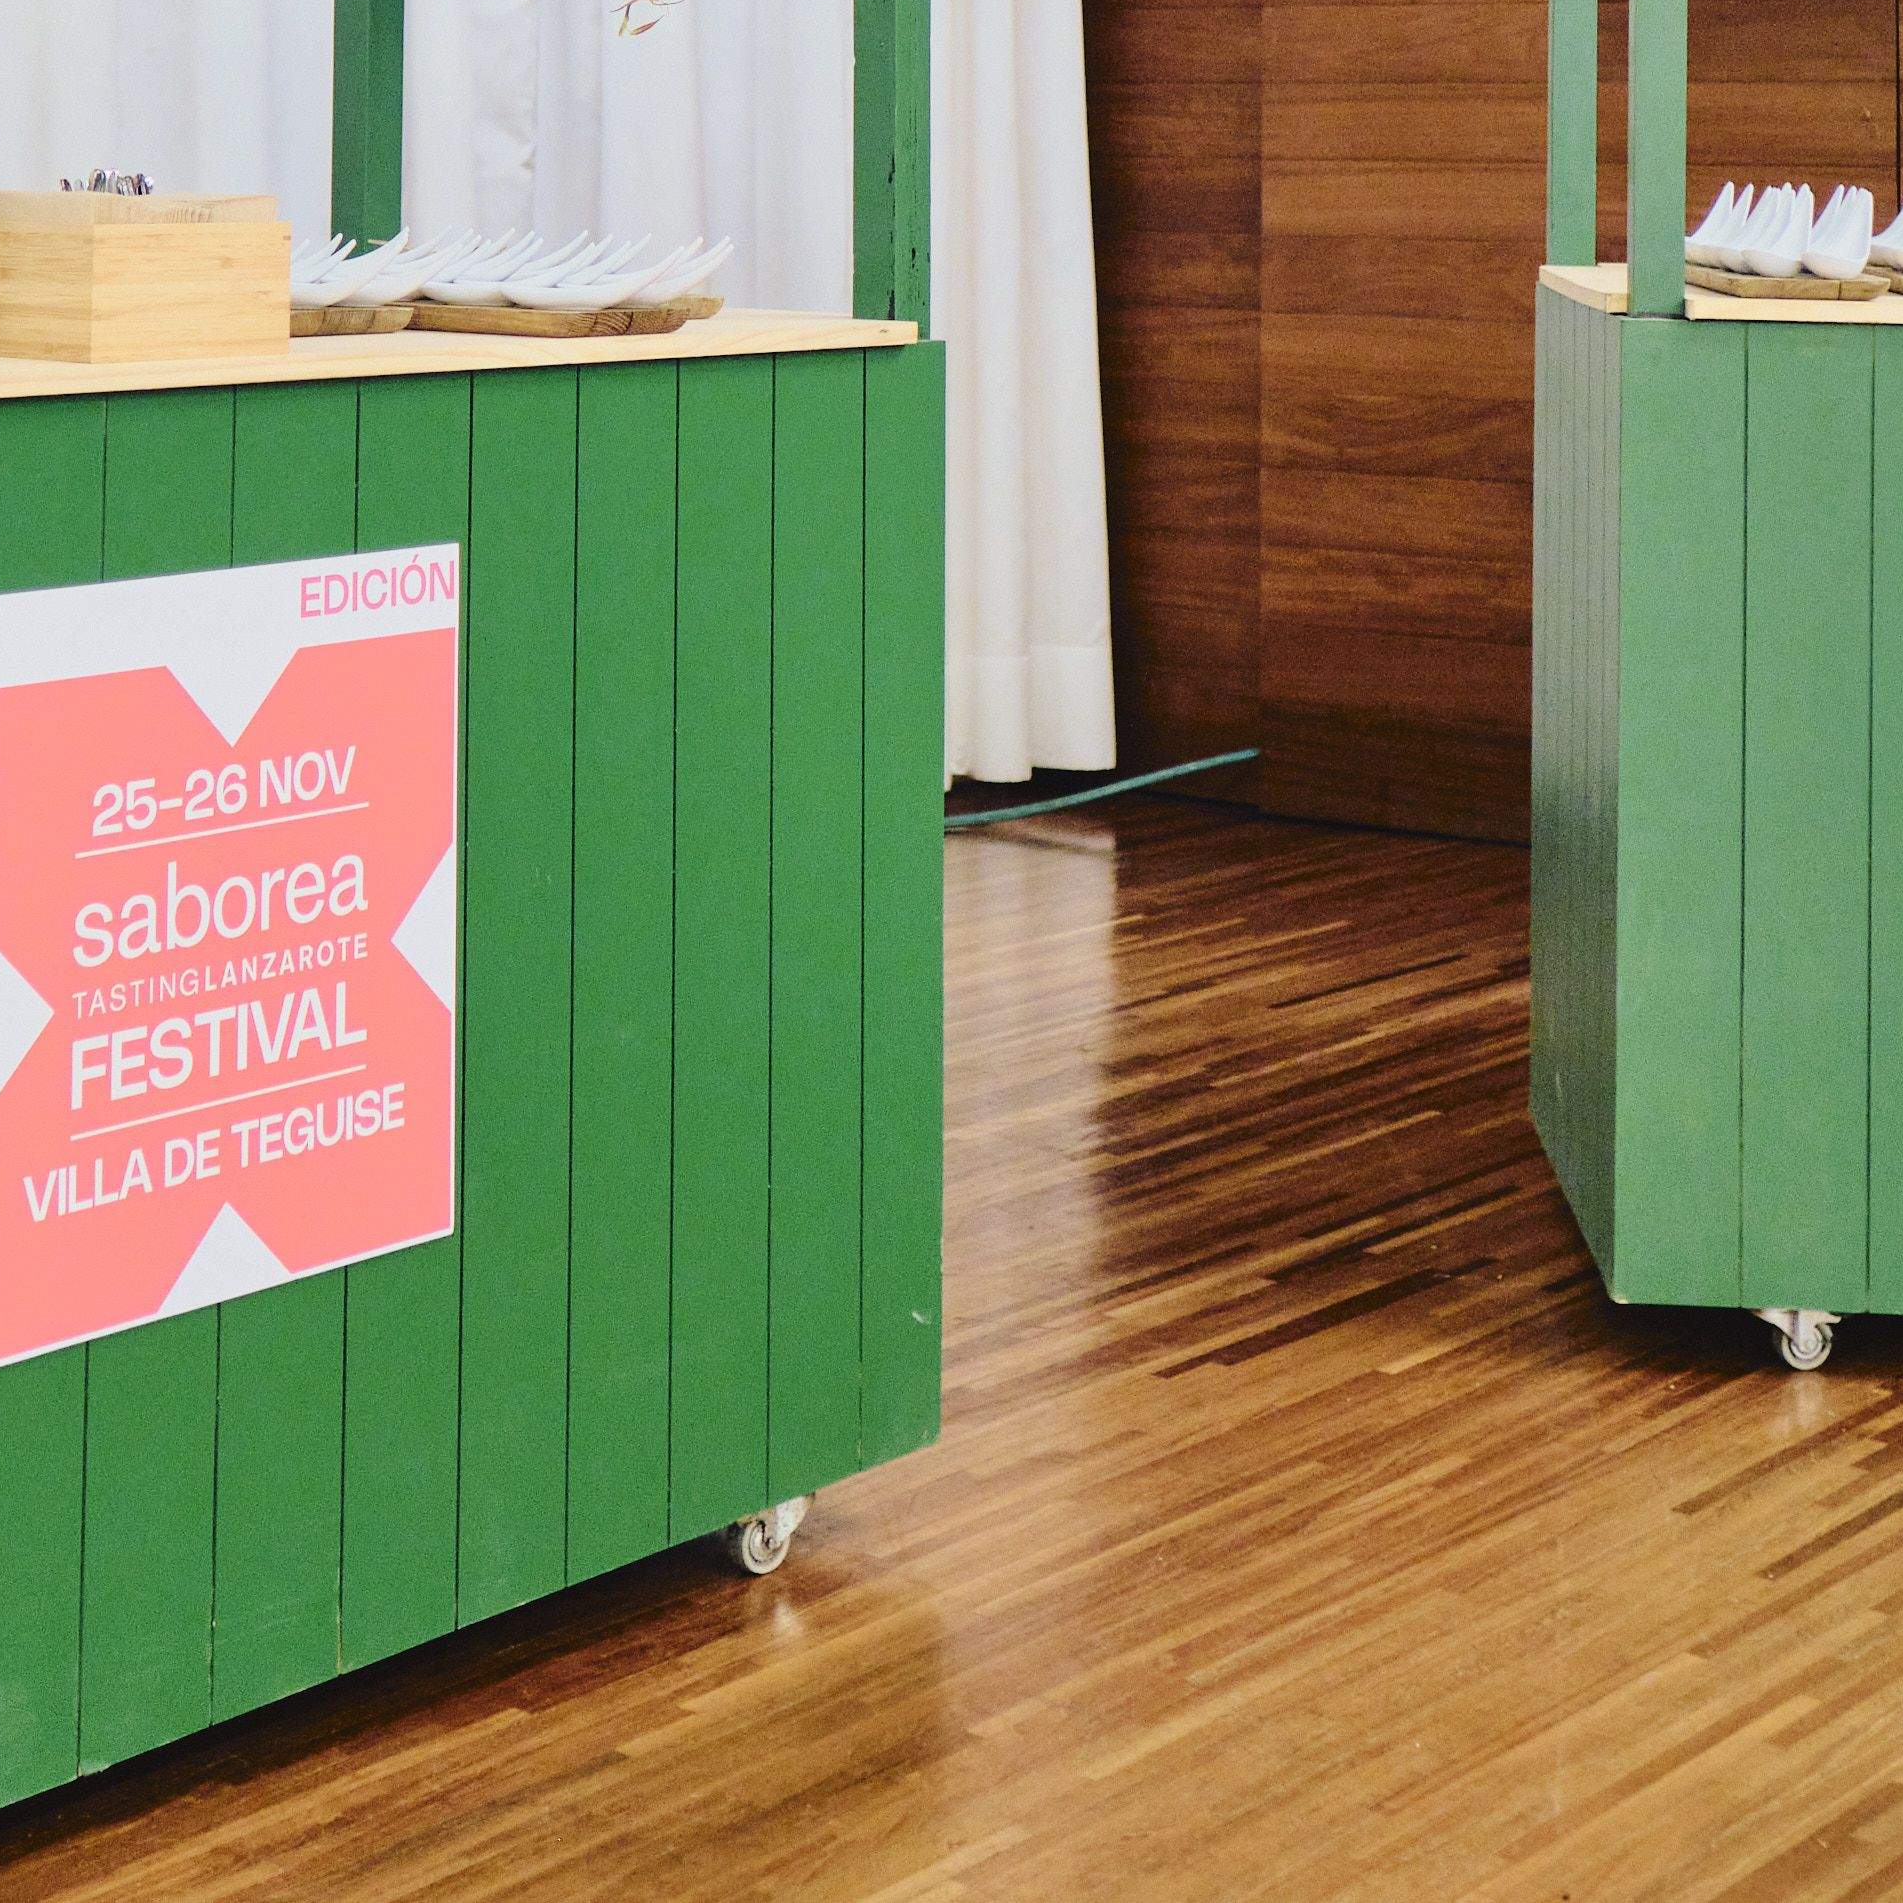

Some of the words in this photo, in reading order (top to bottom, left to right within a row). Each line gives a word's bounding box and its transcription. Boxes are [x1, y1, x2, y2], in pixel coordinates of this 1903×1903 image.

[299, 553, 456, 620] EDICIÓN
[91, 762, 248, 838] 25-26
[258, 745, 357, 807] NOV
[71, 851, 368, 969] saborea
[71, 933, 368, 1020] TASTINGLANZAROTE
[70, 980, 368, 1110] FESTIVAL
[22, 1147, 153, 1223] VILLA
[162, 1125, 222, 1186] DE
[230, 1082, 406, 1167] TEGUISE
